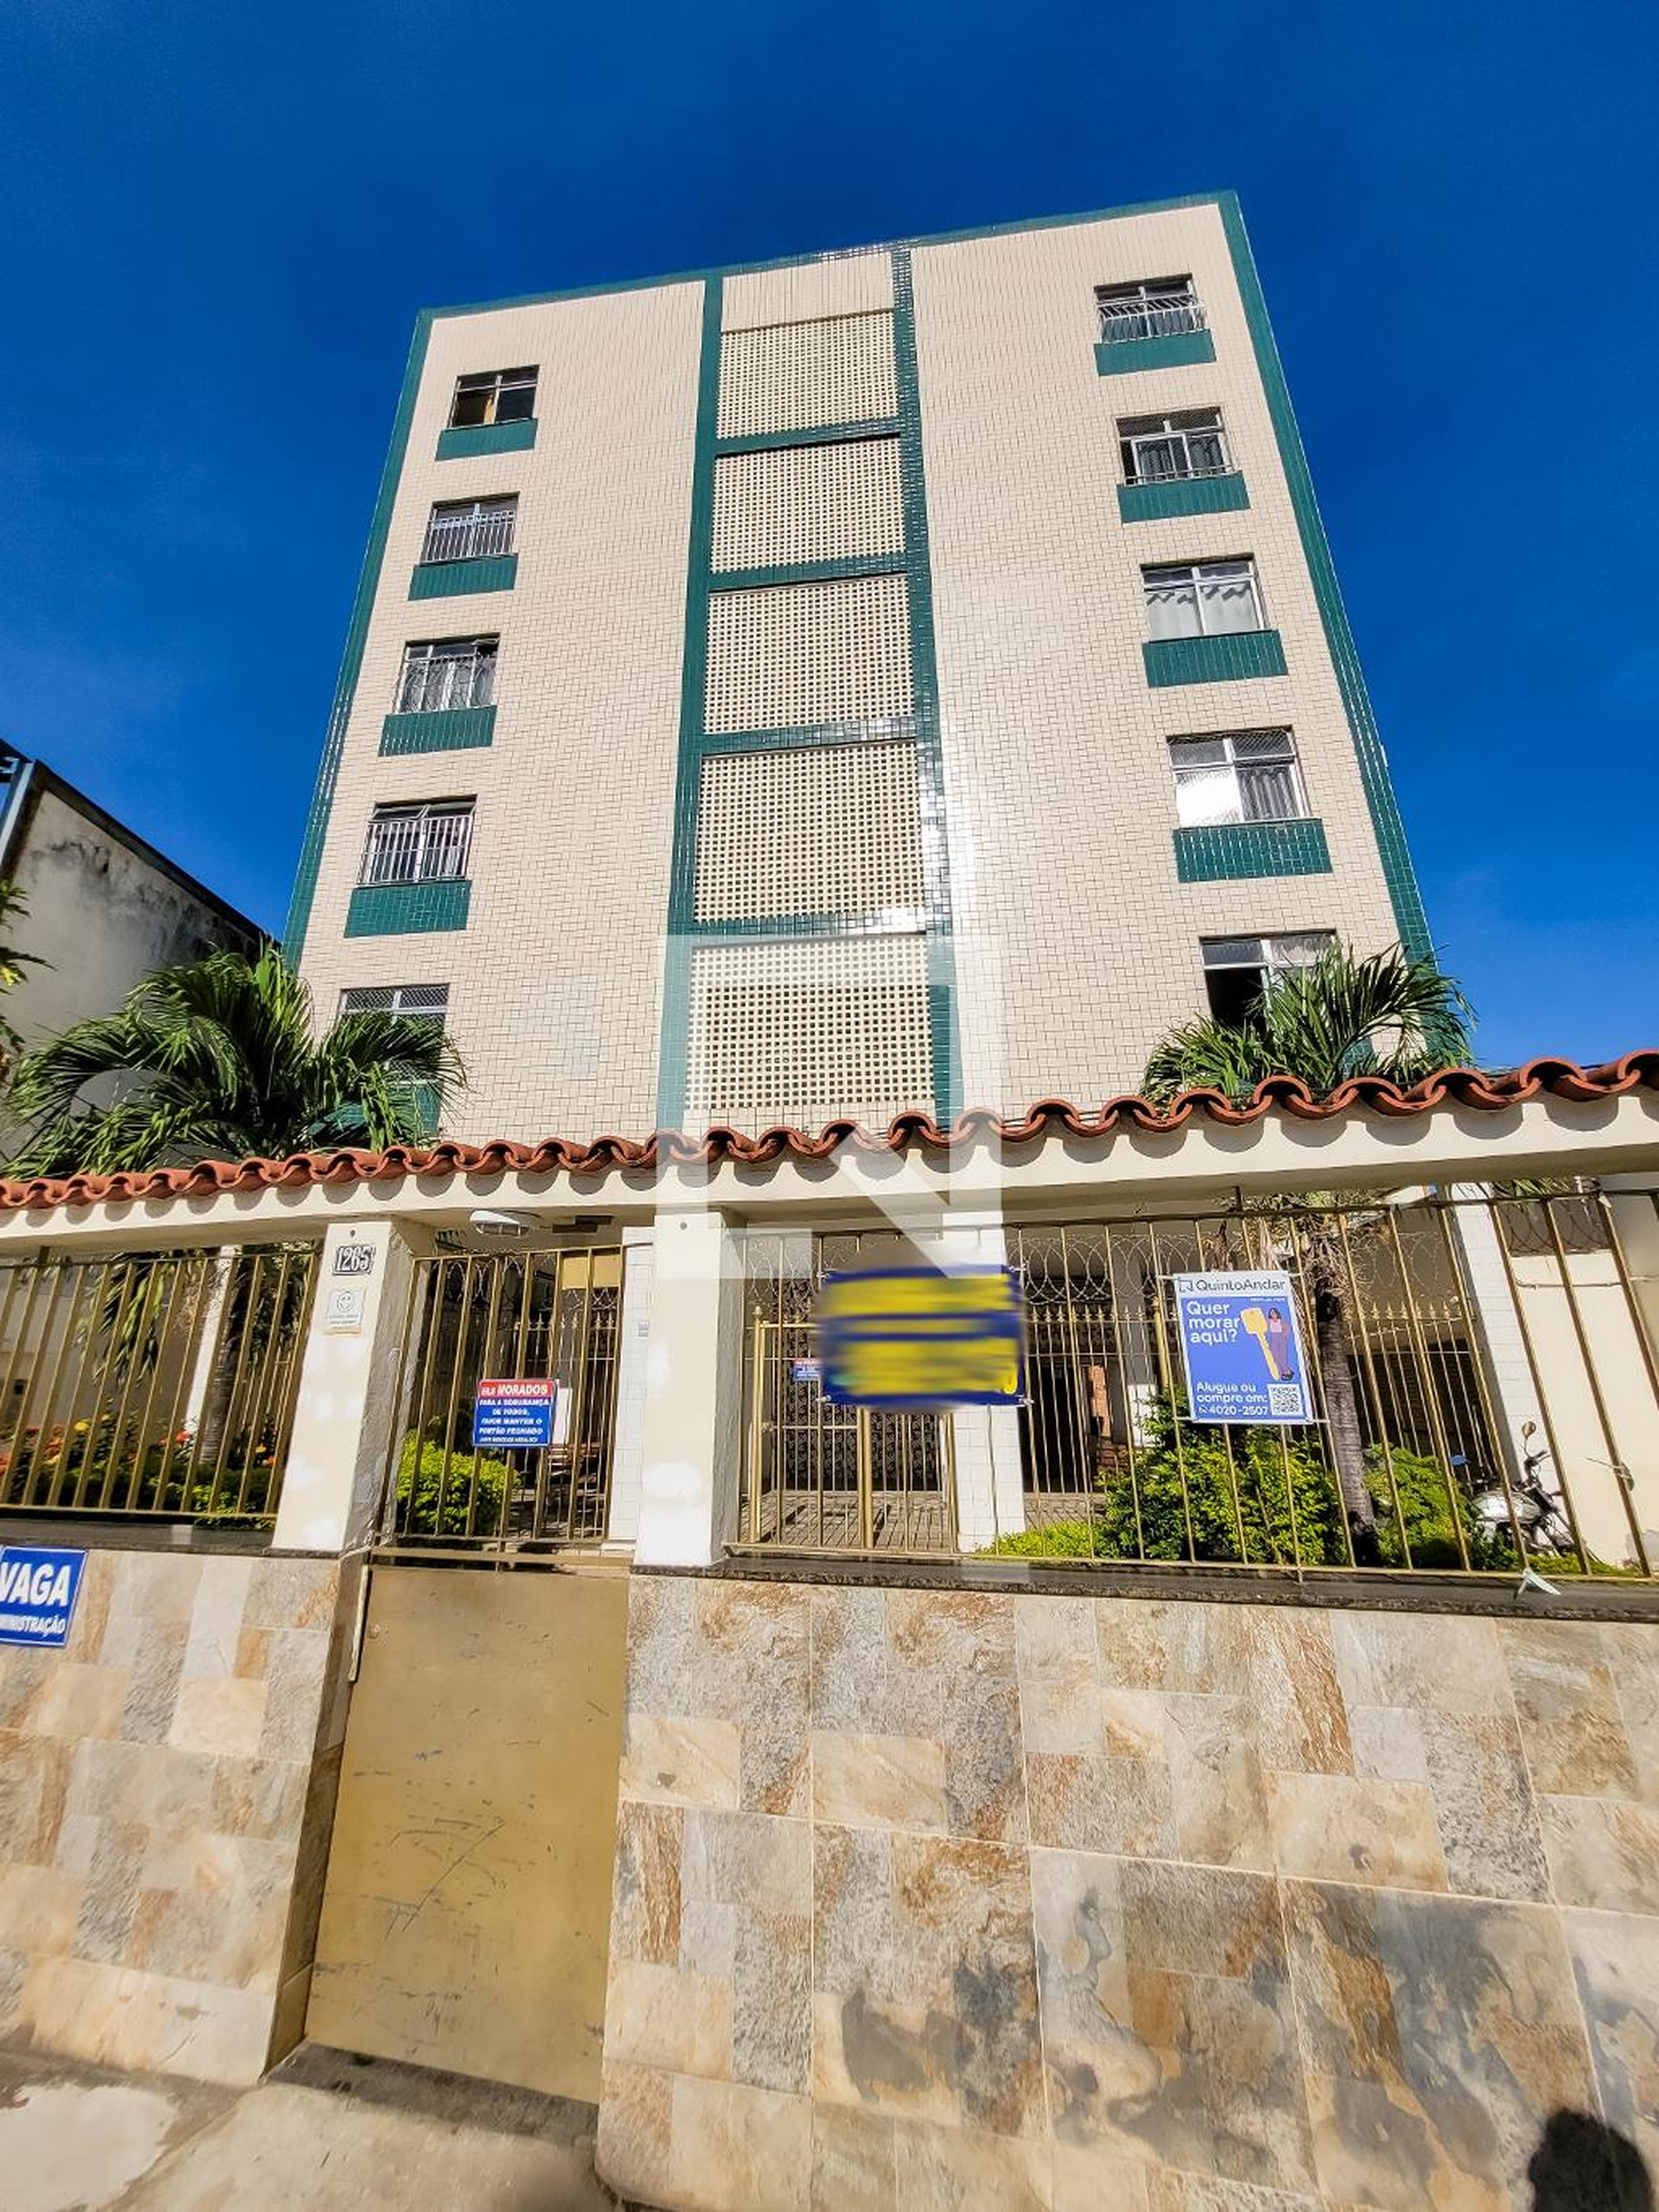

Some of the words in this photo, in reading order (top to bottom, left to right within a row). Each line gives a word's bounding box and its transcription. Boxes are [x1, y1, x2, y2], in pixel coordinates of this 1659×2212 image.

[1196, 1279, 1285, 1291] QuintoAndar
[1187, 1301, 1230, 1315] Quer
[1189, 1318, 1240, 1329] morar
[1190, 1329, 1238, 1346] aqui?
[1197, 1381, 1238, 1394] Alugue
[1241, 1383, 1256, 1392] ou
[0, 1561, 70, 1607] VAGA
